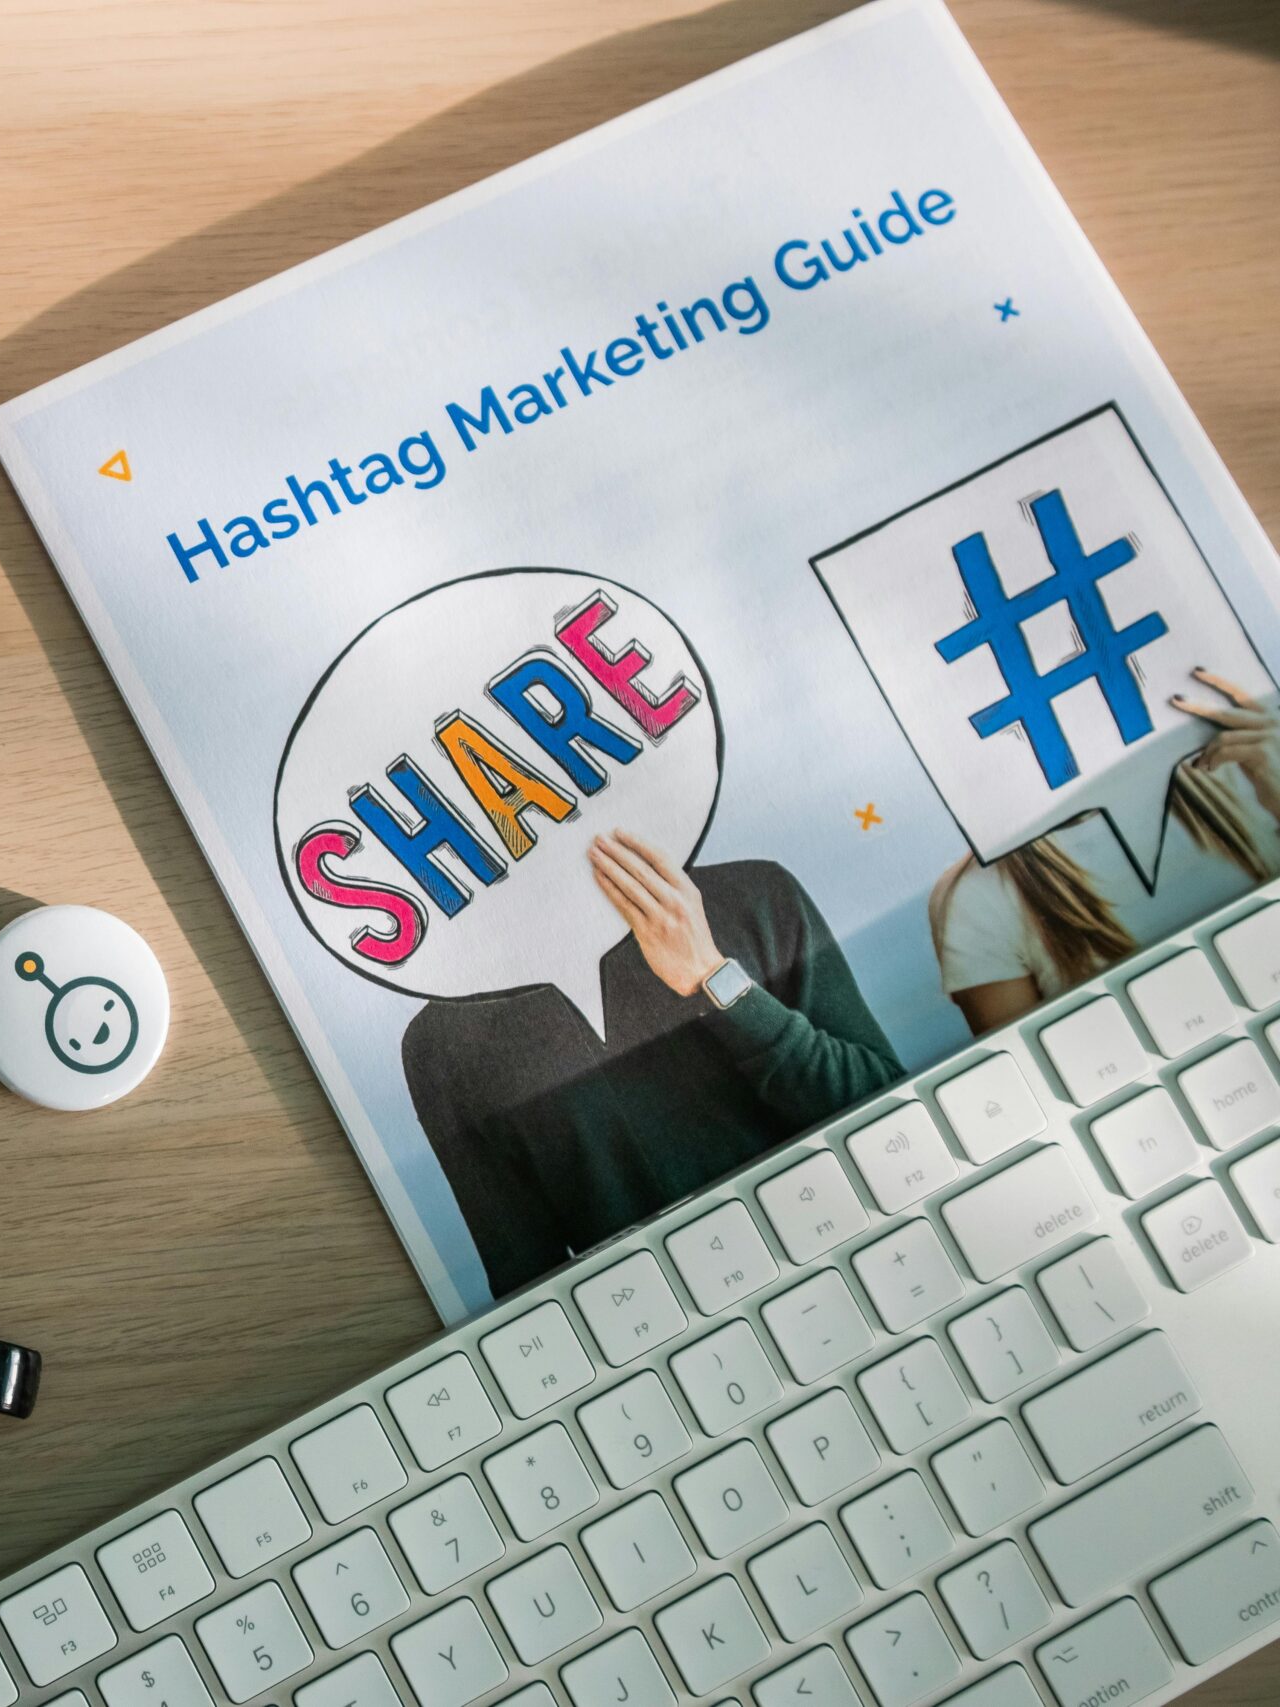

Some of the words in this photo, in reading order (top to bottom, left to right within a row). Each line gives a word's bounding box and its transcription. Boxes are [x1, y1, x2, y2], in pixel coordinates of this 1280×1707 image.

[166, 431, 447, 584] Hashtag
[445, 276, 770, 452] Marketing
[774, 187, 957, 292] Guide
[294, 589, 702, 967] SHARE
[1184, 1015, 1205, 1031] F14
[1097, 1062, 1118, 1081] F13
[1213, 1081, 1258, 1111] home
[1137, 1135, 1158, 1154] fn
[904, 1169, 925, 1187] F12
[815, 1220, 835, 1237] F11
[1034, 1203, 1084, 1239] delete
[1180, 1228, 1229, 1263] delete
[723, 1270, 745, 1288] F10
[633, 1322, 649, 1338] F9
[540, 1373, 558, 1389] F8
[726, 1382, 746, 1406] 0
[1138, 1390, 1188, 1427] return
[447, 1425, 461, 1441] F7
[633, 1433, 653, 1458] 9
[812, 1435, 830, 1461] P
[352, 1479, 369, 1494] F6
[540, 1486, 561, 1511] 8
[722, 1487, 743, 1512] O
[1202, 1485, 1242, 1517] shift
[255, 1531, 273, 1548] F5
[444, 1537, 460, 1563] 7
[632, 1542, 646, 1564] I
[158, 1585, 176, 1601] F4
[796, 1574, 818, 1596] L
[350, 1592, 370, 1617] 6
[532, 1591, 556, 1618] U
[1238, 1587, 1280, 1622] contr
[60, 1640, 78, 1656] F3
[701, 1623, 726, 1651] K
[252, 1645, 273, 1671] 5
[437, 1645, 457, 1671] Y
[617, 1677, 629, 1703] J
